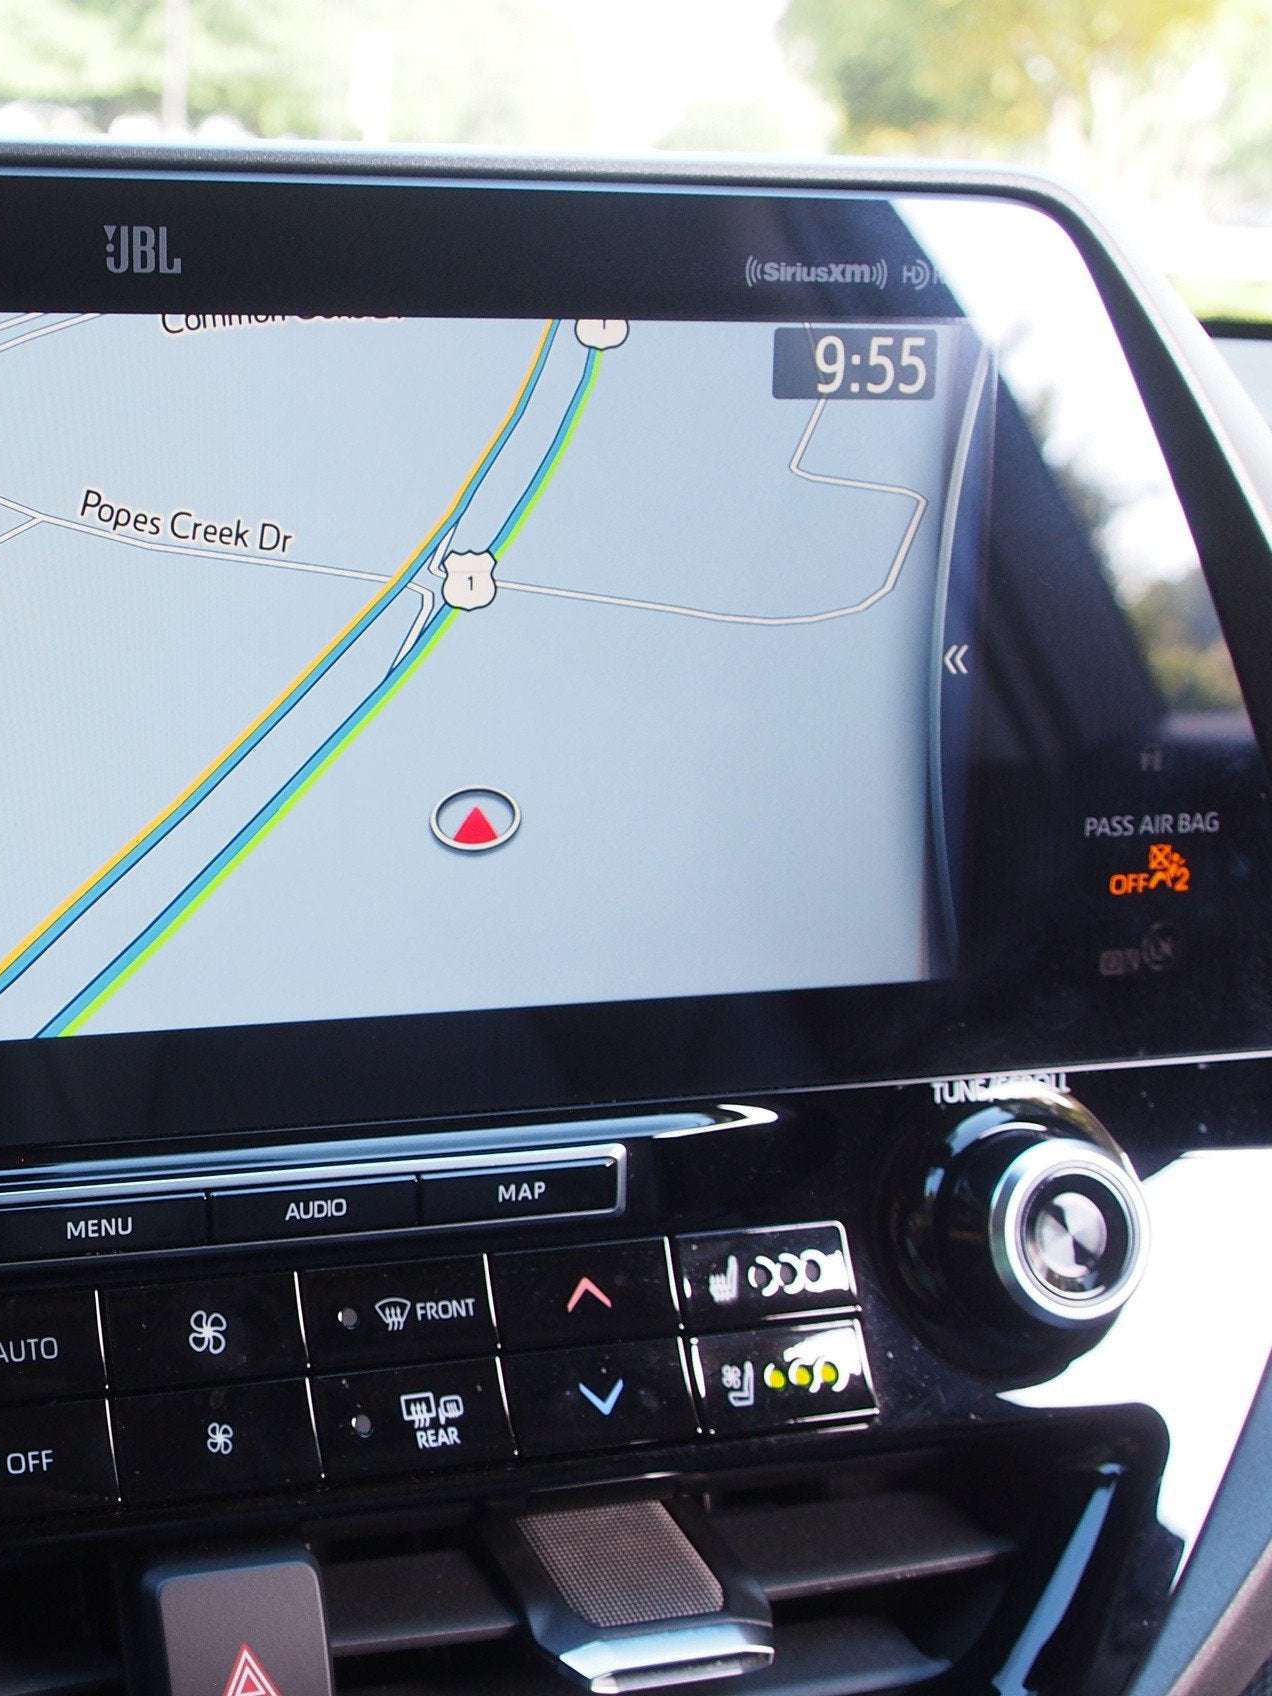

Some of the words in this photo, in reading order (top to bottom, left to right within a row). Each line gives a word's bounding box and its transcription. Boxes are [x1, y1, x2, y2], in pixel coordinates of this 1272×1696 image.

[104, 225, 182, 275] JBL
[814, 335, 927, 394] 9:55
[80, 489, 161, 536] Popes
[170, 511, 250, 548] Creek
[259, 522, 294, 554] Dr
[466, 576, 475, 592] 1
[1083, 814, 1134, 838] PASS
[1138, 812, 1174, 836] AIR
[1178, 810, 1220, 834] BAG
[1109, 872, 1150, 896] OFF
[497, 1181, 546, 1203] MAP
[285, 1198, 348, 1221] AUDIO
[66, 1216, 133, 1240] MENU
[416, 1297, 476, 1322] FRONT
[415, 1425, 462, 1450] REAR
[6, 1449, 54, 1475] OFF
